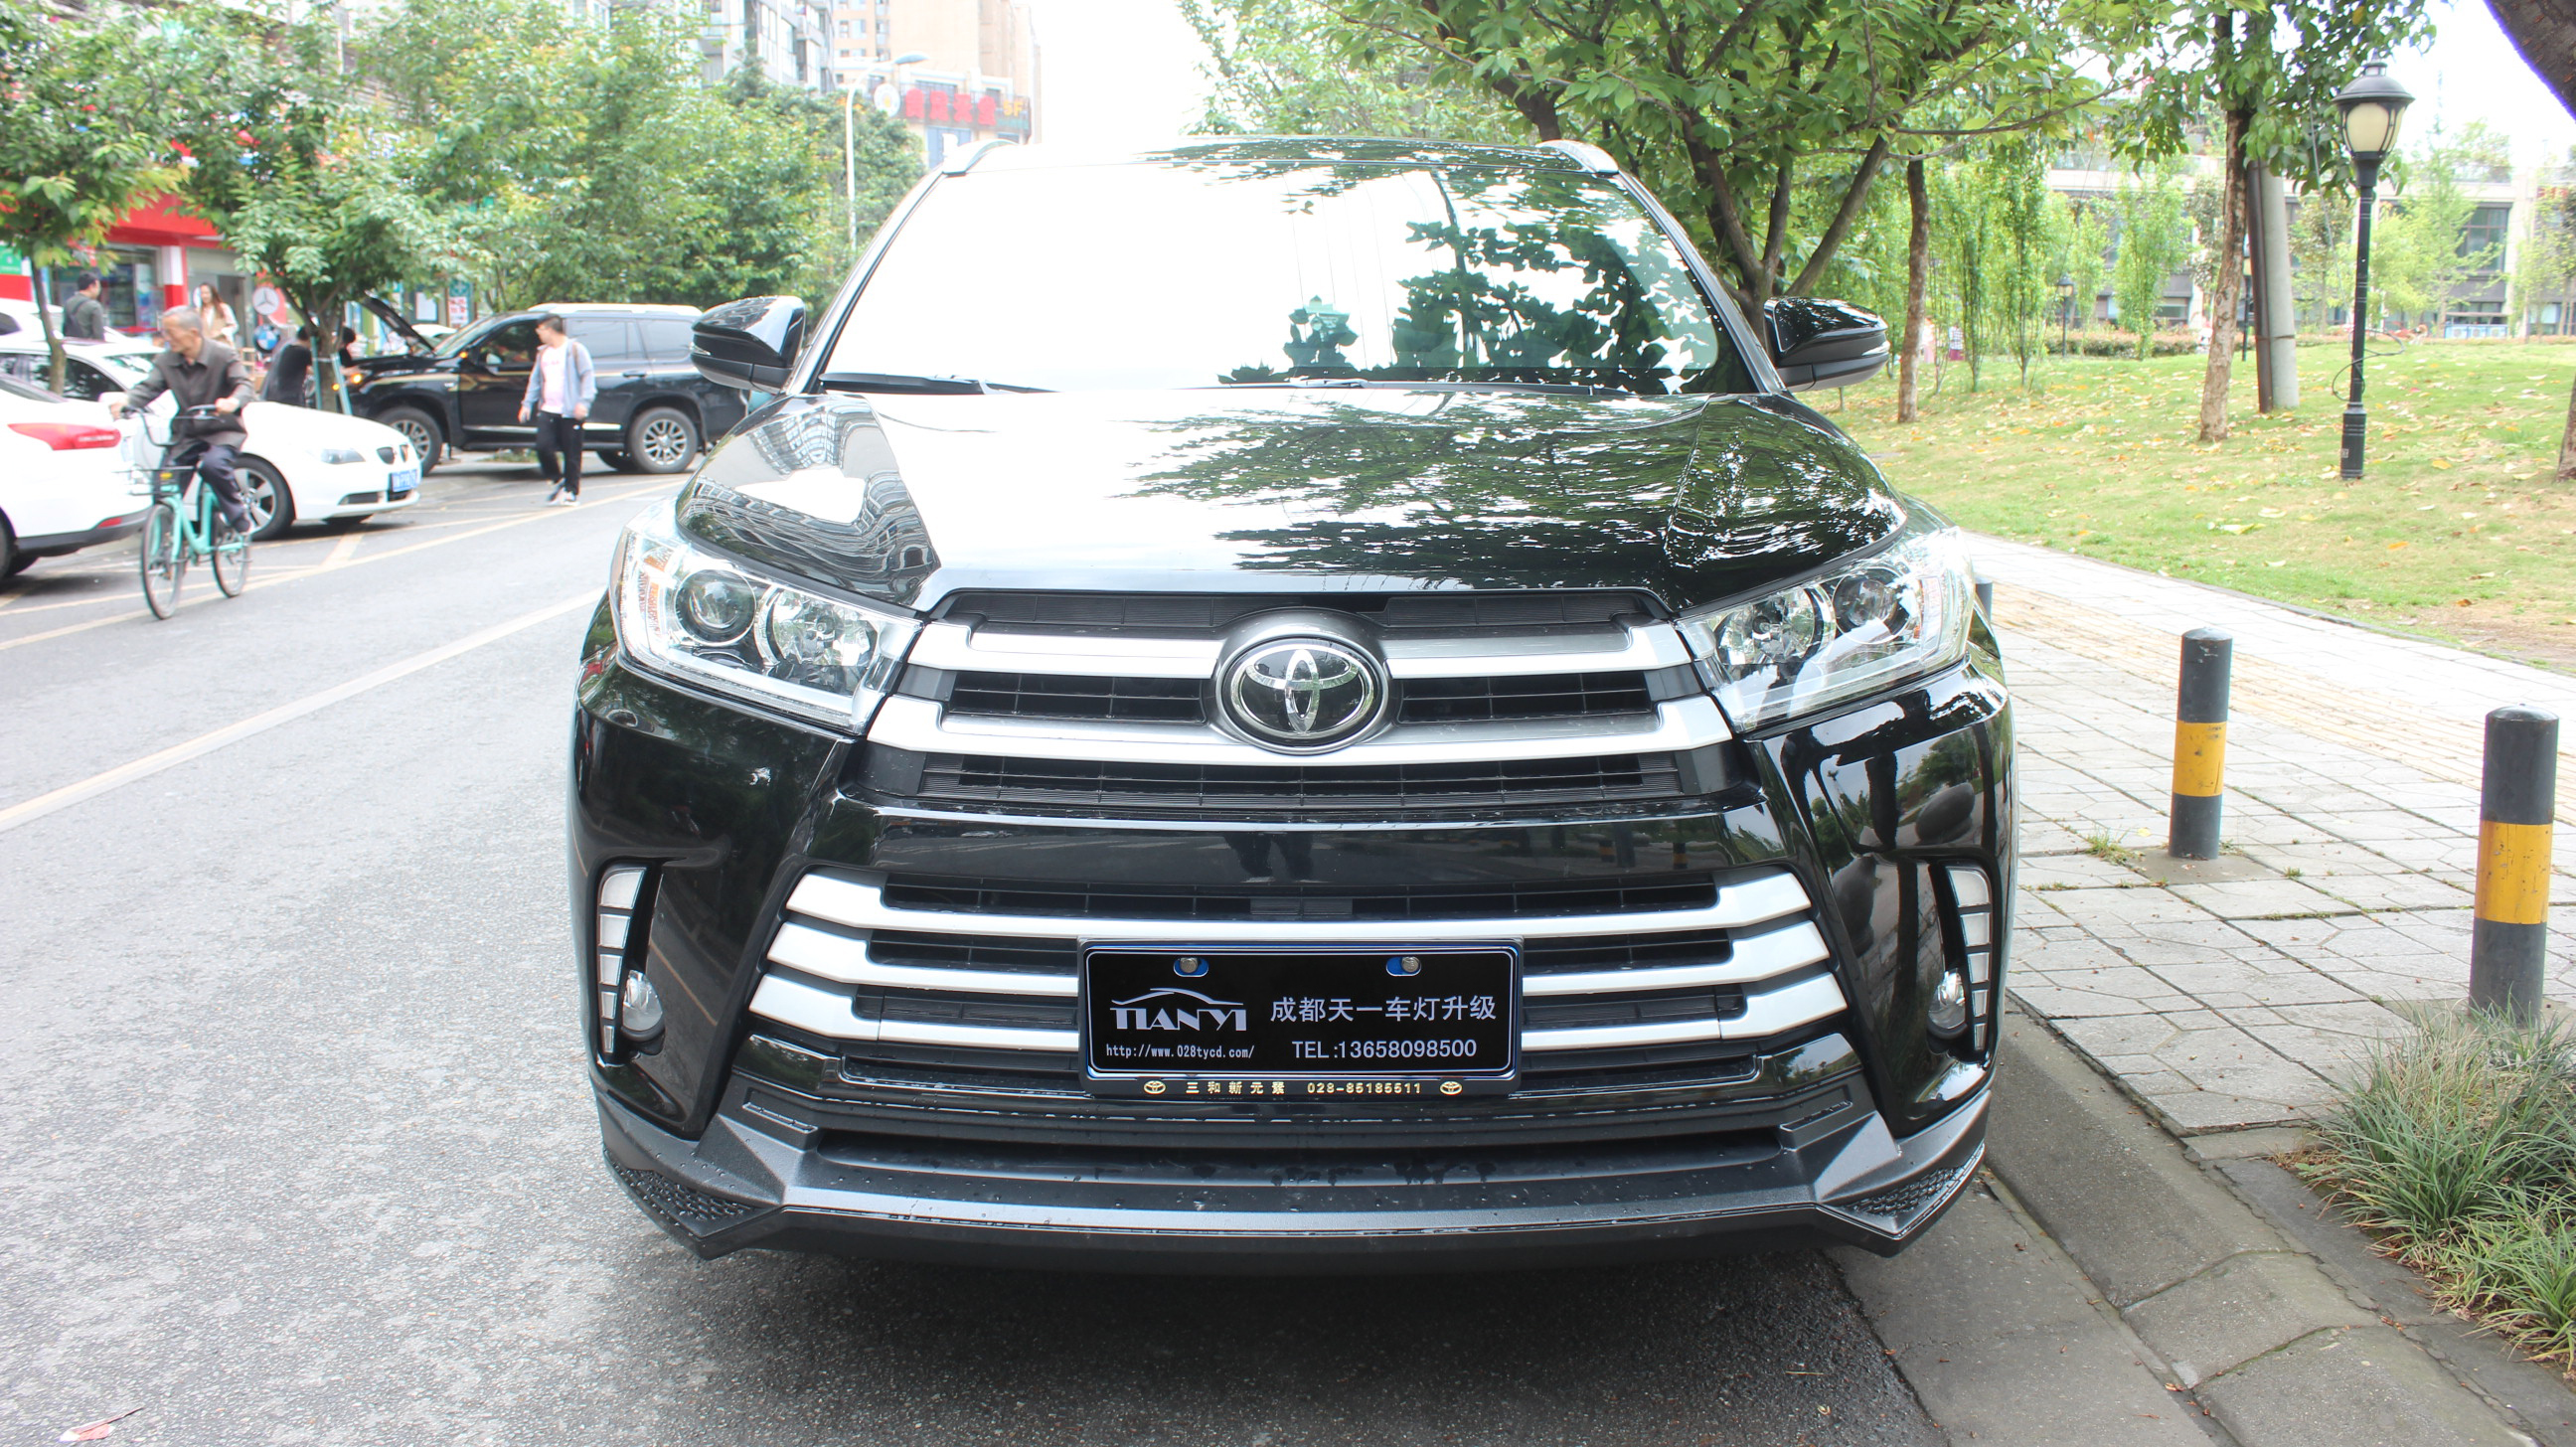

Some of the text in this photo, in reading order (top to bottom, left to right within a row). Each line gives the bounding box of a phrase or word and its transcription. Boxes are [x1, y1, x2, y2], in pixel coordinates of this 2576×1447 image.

[1270, 995, 1497, 1022] 成都天一车灯升级
[1109, 1007, 1247, 1032] TIANYI
[1105, 1044, 1255, 1059] http://www.028tycd.com/
[1307, 1081, 1421, 1094] 028-85185511
